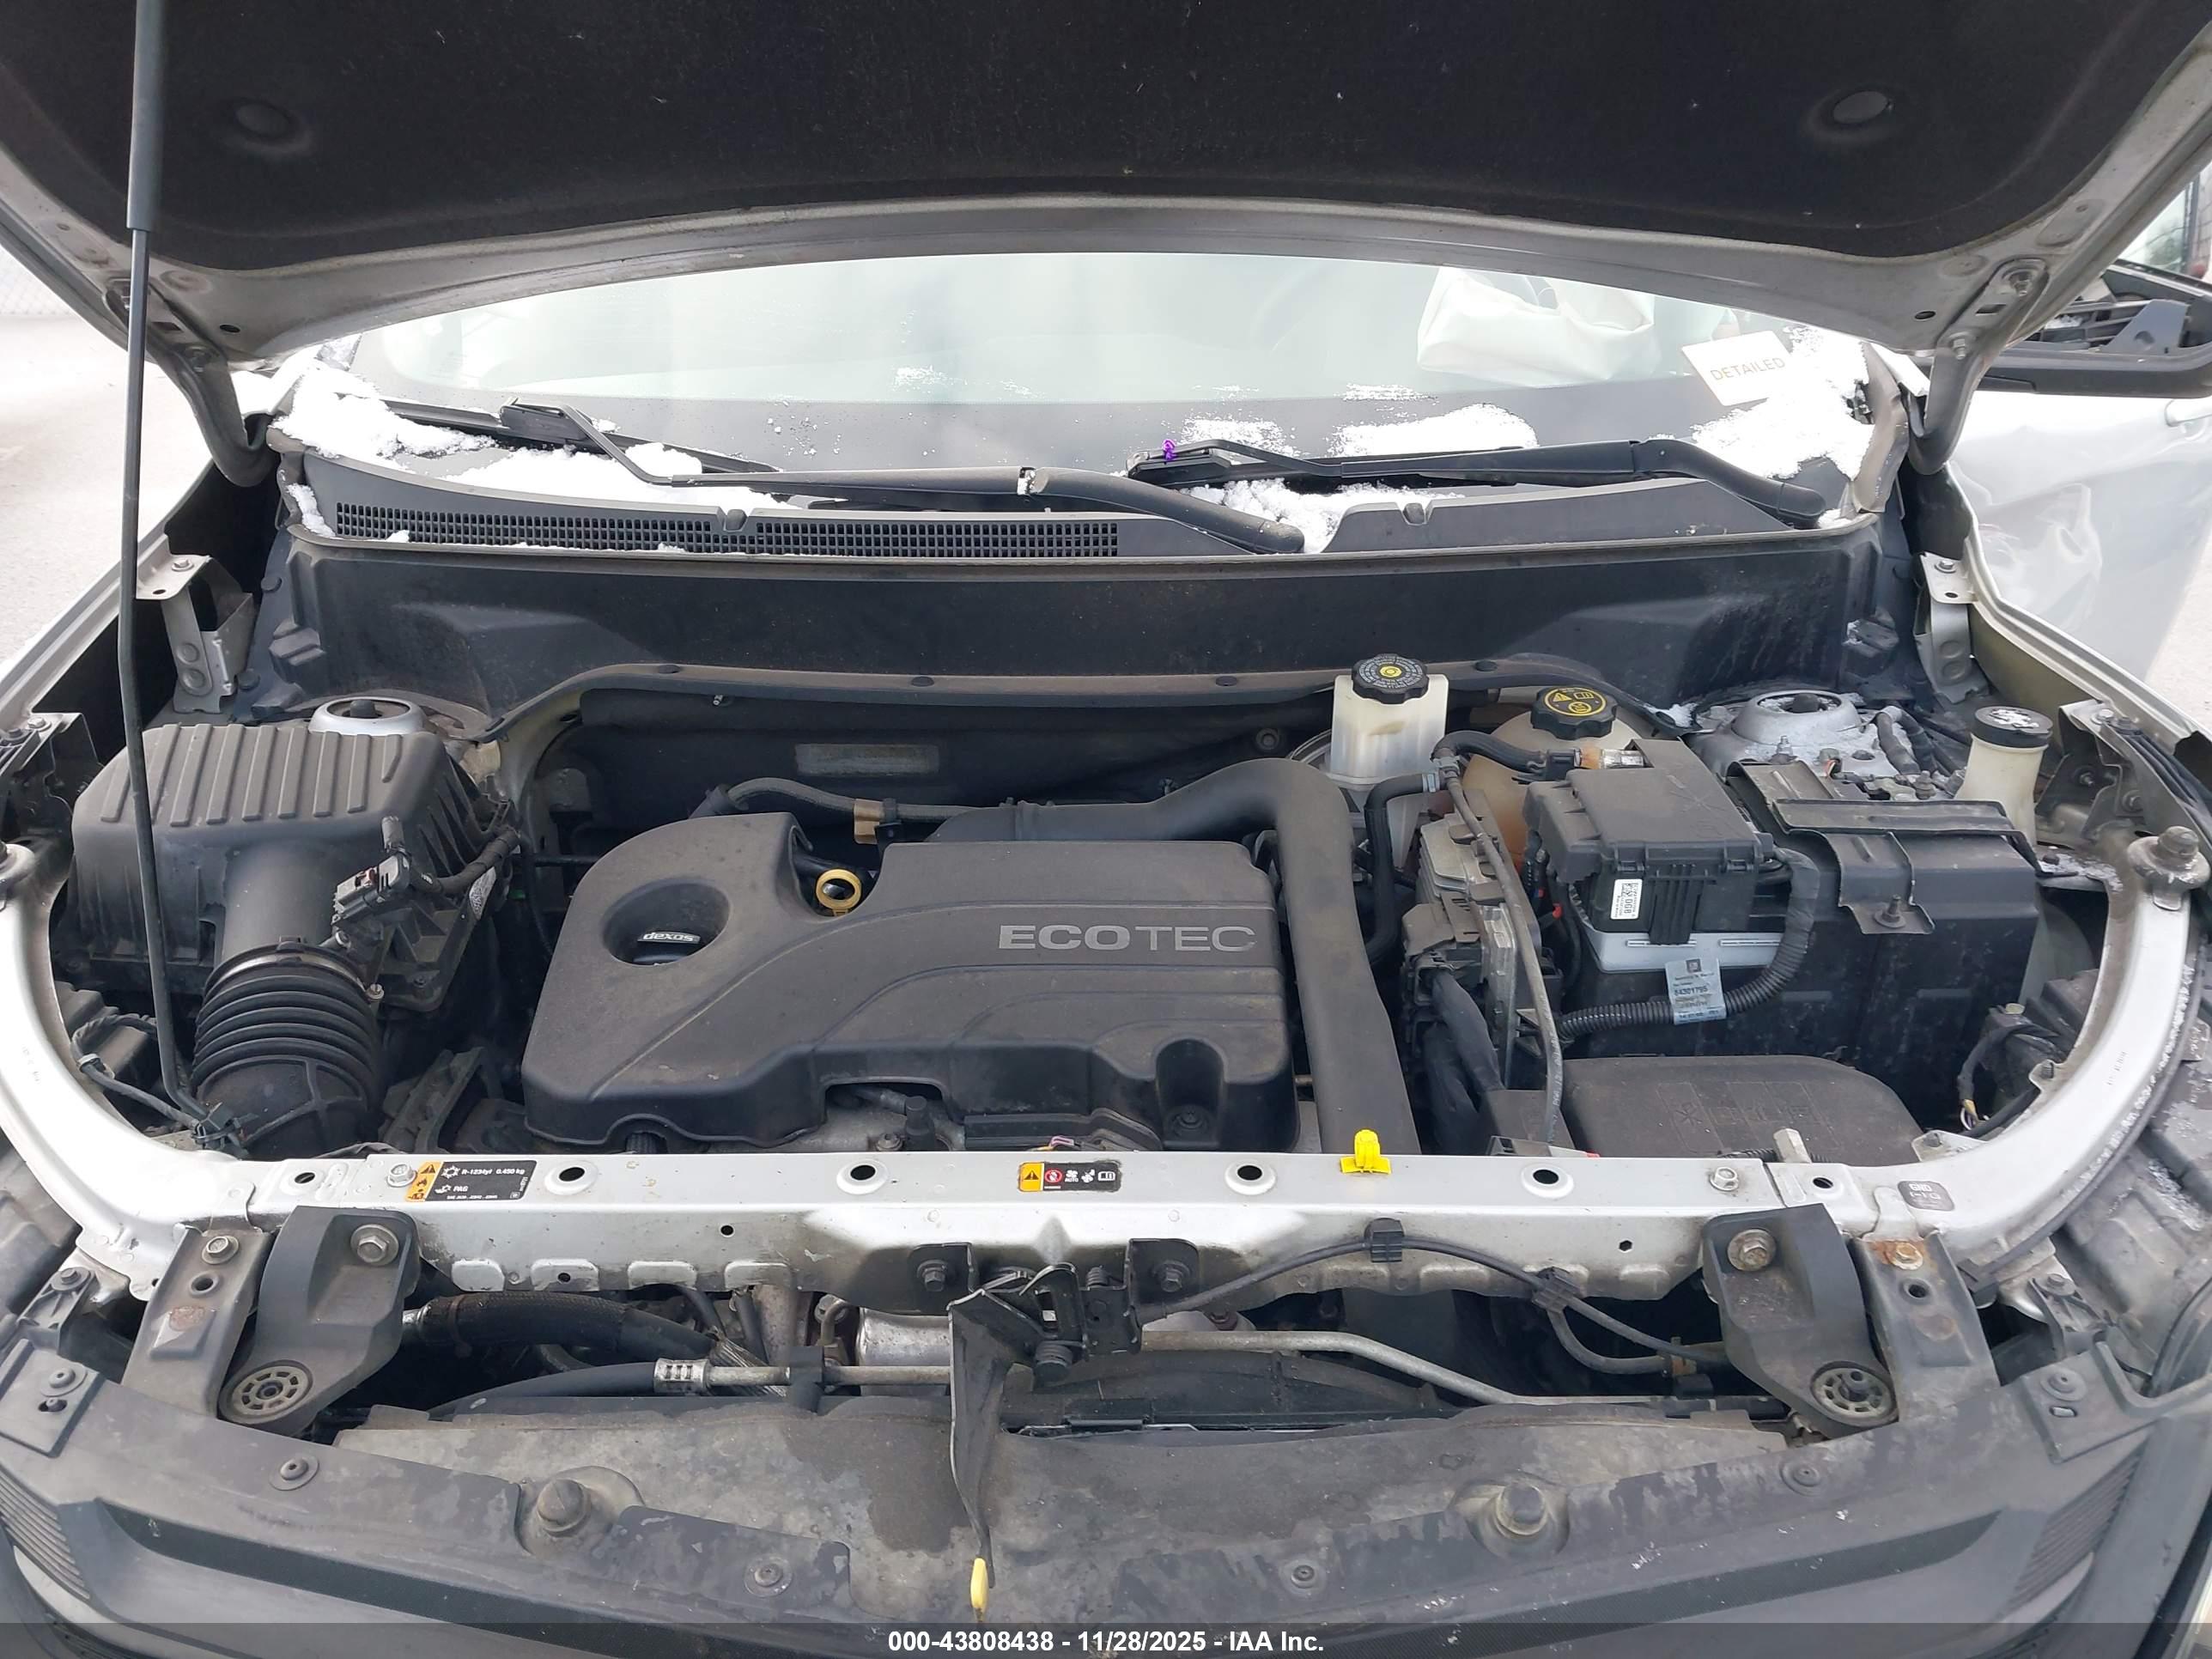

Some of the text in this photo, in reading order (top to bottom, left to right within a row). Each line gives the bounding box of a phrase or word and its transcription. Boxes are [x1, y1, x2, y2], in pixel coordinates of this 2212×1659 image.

[1710, 357, 1786, 380] DETAILED
[642, 932, 695, 942] dexos
[999, 924, 1258, 952] ECOTEC
